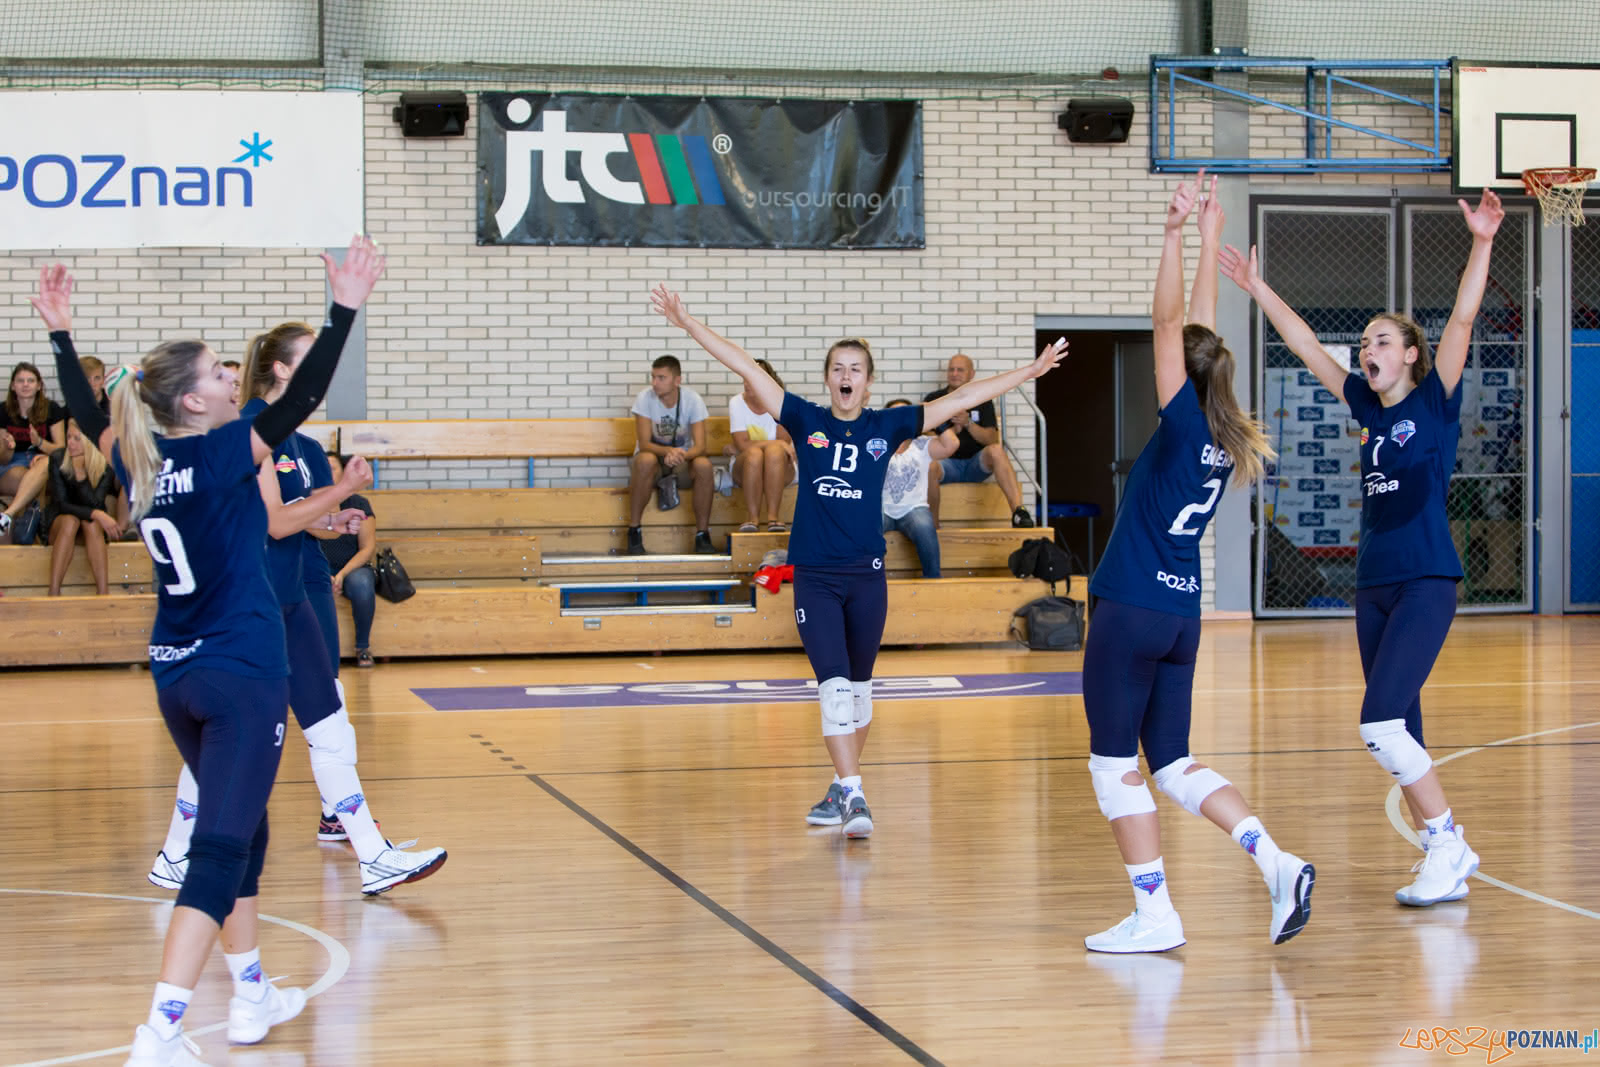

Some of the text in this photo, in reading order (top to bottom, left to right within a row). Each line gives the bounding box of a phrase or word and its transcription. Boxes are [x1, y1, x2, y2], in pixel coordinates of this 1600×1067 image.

[495, 98, 645, 239] jtc
[742, 185, 912, 214] outsourcing IT
[832, 442, 859, 472] 13
[1372, 435, 1386, 467] 7
[817, 482, 863, 499] Enea
[1367, 479, 1400, 497] Enea
[1167, 478, 1222, 536] 2
[140, 517, 196, 596] 9
[795, 608, 806, 624] 13
[274, 722, 285, 746] 9
